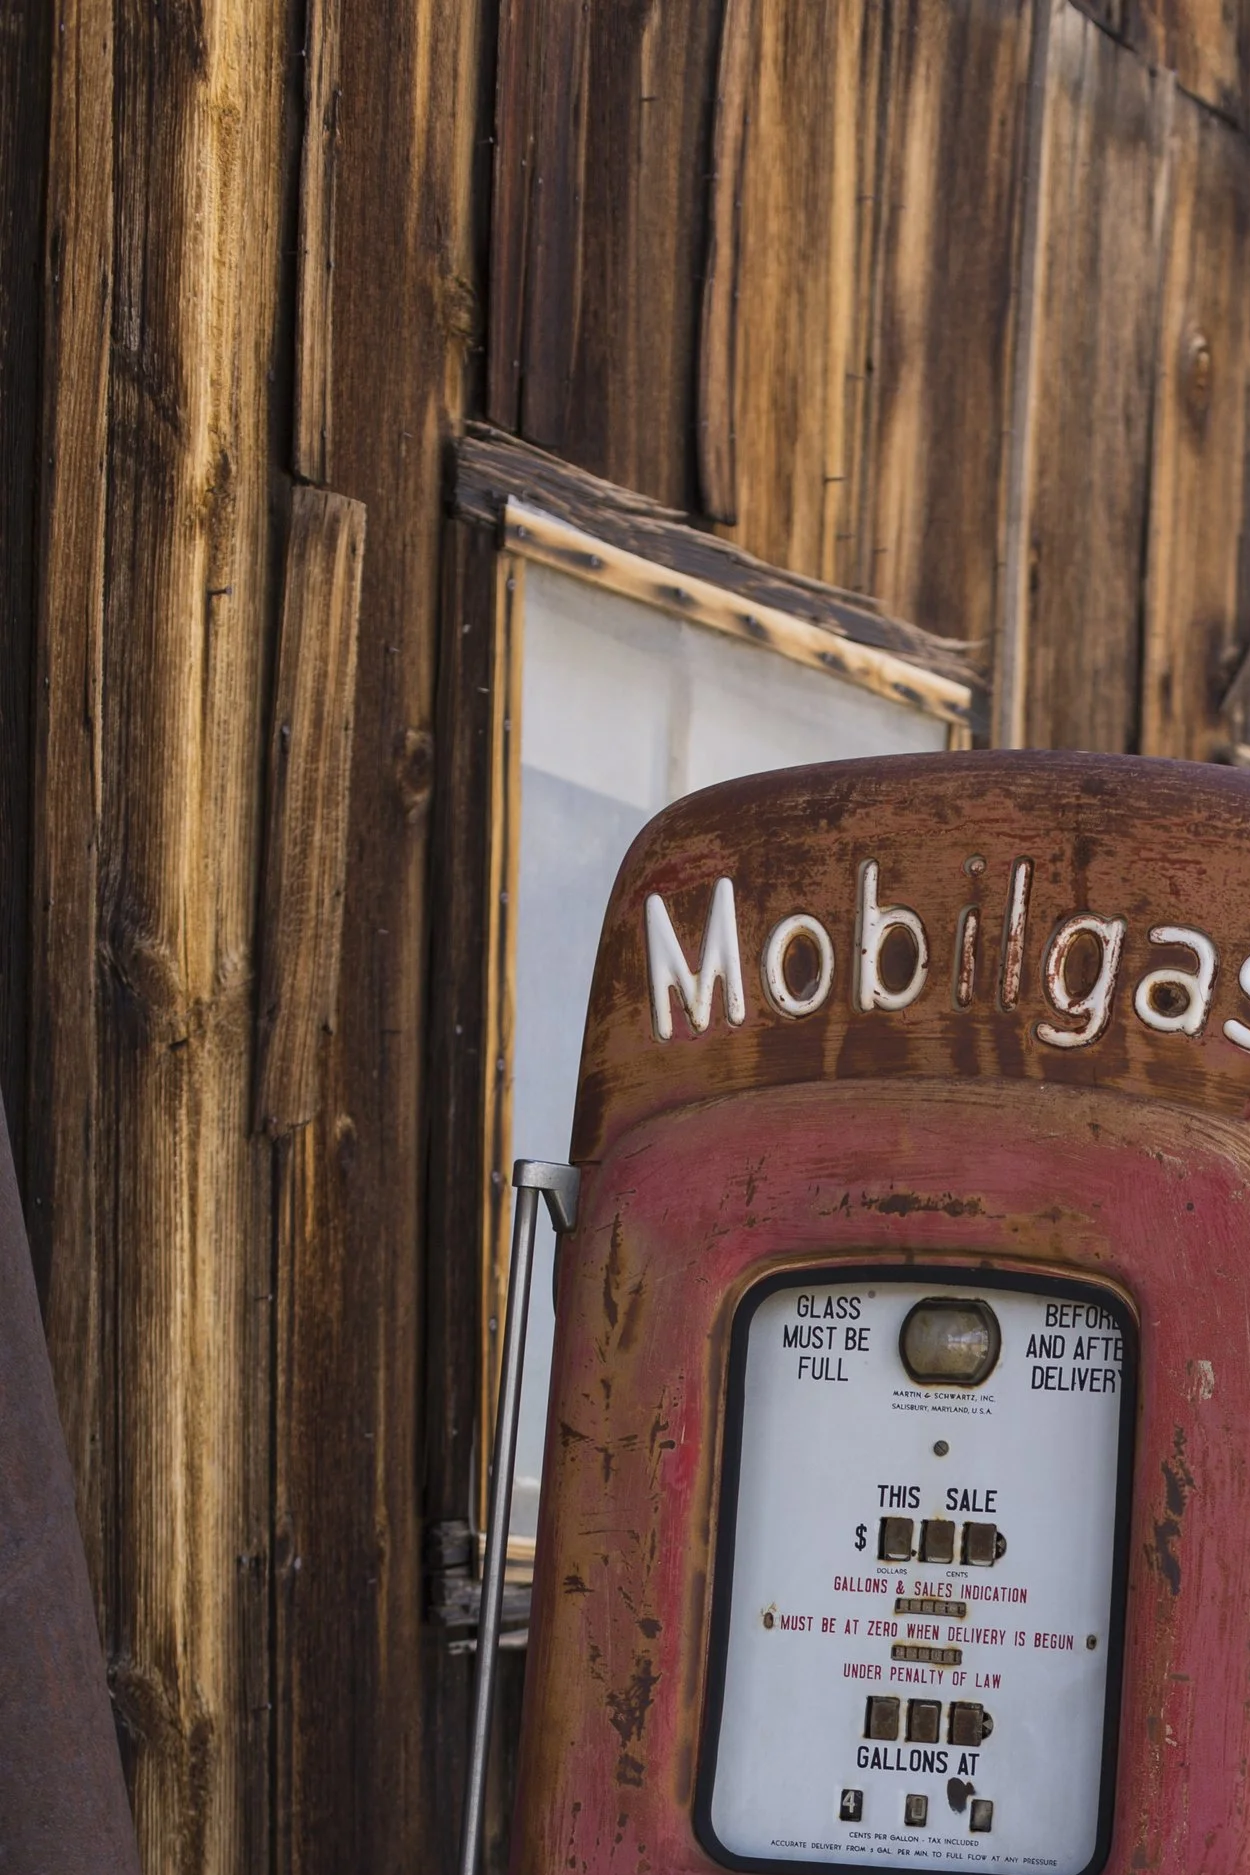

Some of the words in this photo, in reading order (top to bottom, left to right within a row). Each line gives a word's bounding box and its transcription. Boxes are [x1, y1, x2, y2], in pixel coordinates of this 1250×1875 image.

[797, 1294, 862, 1320] GLASS
[782, 1324, 838, 1350] MUST
[844, 1326, 871, 1352] BE
[1025, 1333, 1066, 1360] AND
[1072, 1335, 1124, 1362] AFTE
[797, 1355, 849, 1382] FULL
[892, 1390, 922, 1399] MARTIN
[934, 1392, 978, 1402] SCHWARTZ,
[892, 1403, 930, 1412] SALISBURY,
[931, 1405, 969, 1414] MARYLAND,
[877, 1484, 921, 1509] THIS
[945, 1487, 998, 1513] SALE
[854, 1523, 868, 1552] $
[876, 1567, 908, 1576] DOLLARS
[945, 1571, 969, 1579] CENTS
[833, 1575, 888, 1594] GALLONS
[895, 1580, 905, 1595] &
[914, 1581, 953, 1598] SALES
[960, 1584, 1028, 1604] INDICATION
[780, 1614, 814, 1632] MUST
[821, 1617, 837, 1633] BE
[844, 1619, 860, 1635] AT
[867, 1620, 898, 1638] ZERO
[907, 1623, 940, 1641] WHEN
[947, 1626, 1007, 1646] DELIVERY
[1014, 1631, 1026, 1647] IS
[1033, 1632, 1074, 1651] BEGUN
[843, 1663, 882, 1680] UNDER
[889, 1666, 944, 1685] PENALTY
[952, 1671, 968, 1687] OF
[975, 1673, 1002, 1689] LAW
[856, 1745, 949, 1774] GALLONS
[957, 1752, 980, 1776] AT
[842, 1790, 855, 1813] 4
[848, 1831, 872, 1840] CENTS
[874, 1833, 888, 1841] PER
[889, 1835, 919, 1843] GALLON
[944, 1838, 980, 1847] INCLUDED
[770, 1840, 807, 1849] ACCURATE
[811, 1842, 843, 1851] DELIVERY
[846, 1844, 866, 1852] FROM
[897, 1848, 911, 1856] PER
[945, 1852, 964, 1860] FULL
[967, 1853, 988, 1861] FLOW
[1004, 1856, 1019, 1864] ANY
[1022, 1857, 1058, 1867] PRESSURE
